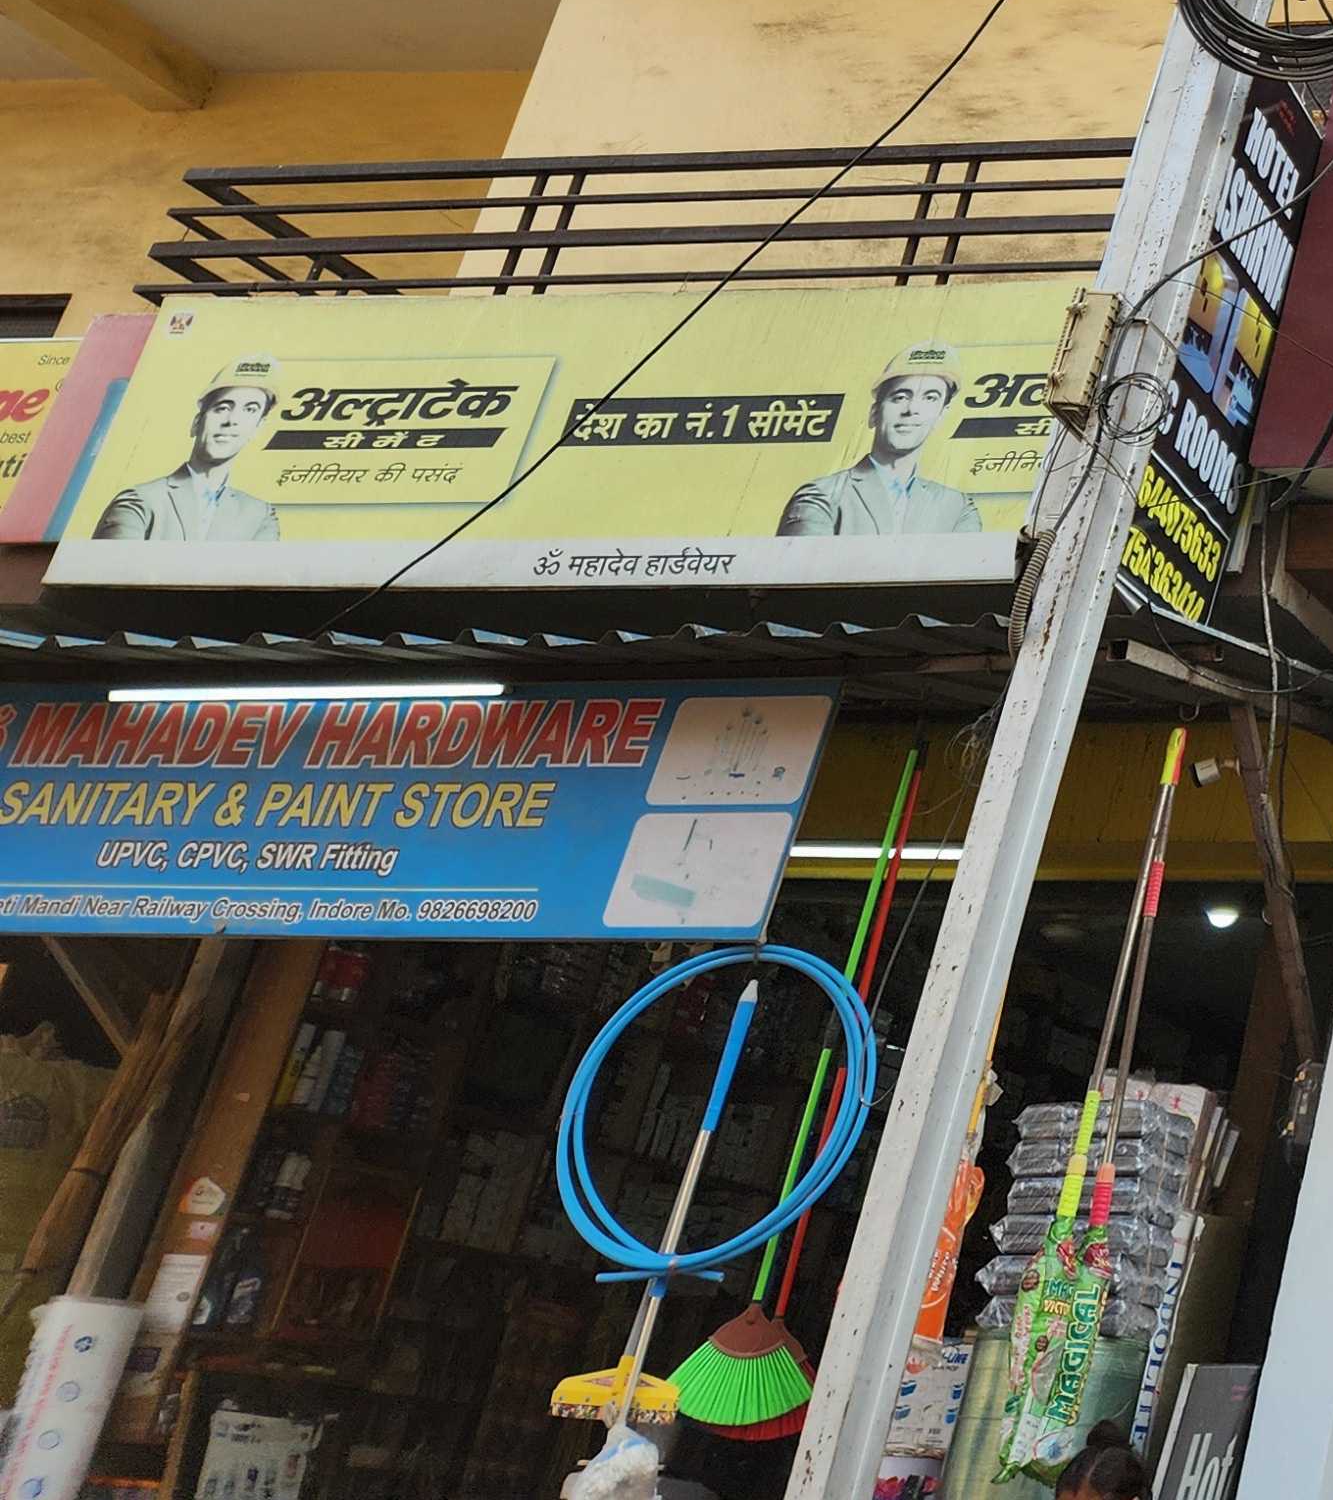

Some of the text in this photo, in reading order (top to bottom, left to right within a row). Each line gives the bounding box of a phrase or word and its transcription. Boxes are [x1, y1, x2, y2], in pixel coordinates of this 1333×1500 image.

[1243, 105, 1301, 221] HOTEL
[37, 353, 71, 367] Since
[573, 404, 621, 441] देश
[633, 411, 677, 439] का
[747, 400, 833, 438] सीमेंट
[375, 461, 405, 485] की
[411, 463, 463, 485] पसंद
[533, 548, 736, 577] ॐ महादेव हार्डवेयर
[8, 701, 306, 768] MAHADEV
[304, 699, 665, 768] HARDWARE
[0, 781, 556, 828] SANITARY & PAINT STORE
[97, 841, 400, 877] UPVC, CPVC, SWR Fitting
[21, 895, 80, 918] Mandi
[80, 896, 132, 918] Near
[134, 896, 206, 924] Railway
[211, 897, 303, 925] Crossing,
[307, 898, 374, 922] Indore
[373, 899, 412, 922] Mo.
[415, 899, 539, 924] 9826698200
